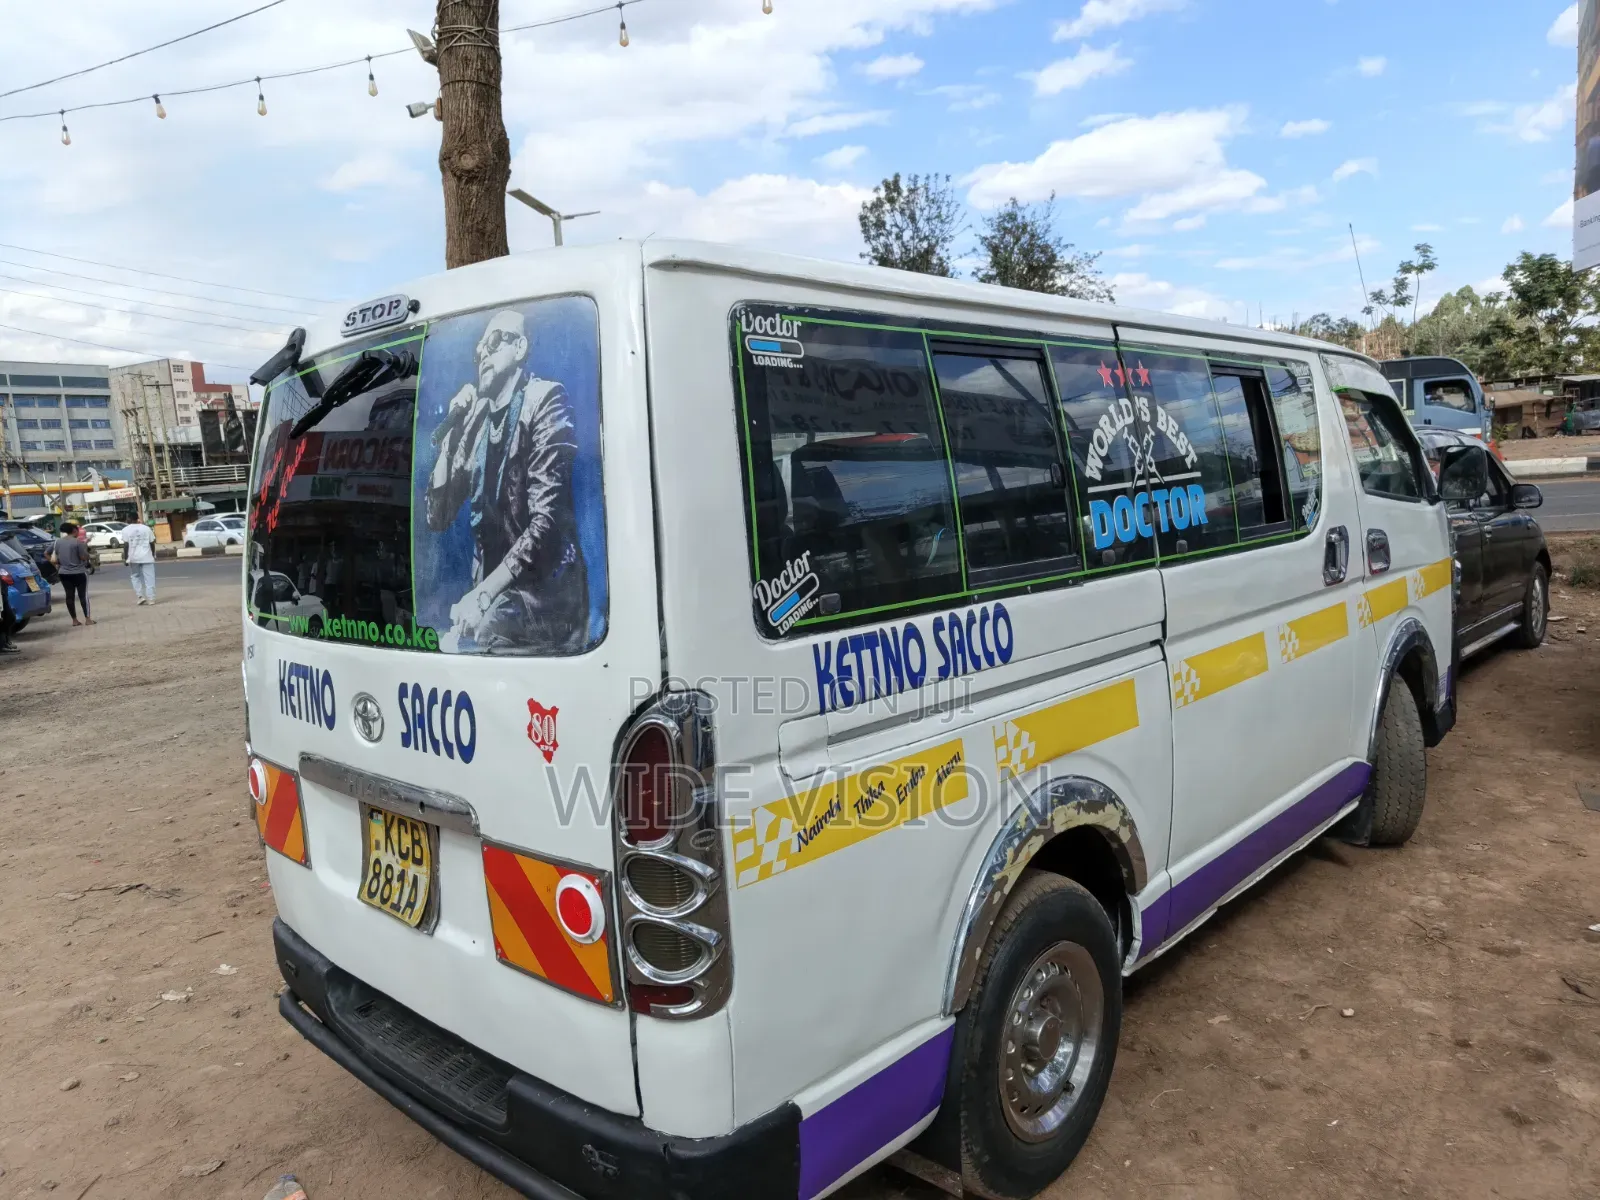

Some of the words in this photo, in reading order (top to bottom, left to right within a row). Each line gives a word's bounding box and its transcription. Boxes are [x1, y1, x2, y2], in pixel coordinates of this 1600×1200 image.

[344, 299, 401, 327] STOP
[737, 306, 802, 338] Doctor
[752, 355, 803, 369] LOADING...
[1085, 396, 1150, 481] WORLD'S
[1156, 404, 1198, 470] BEST
[1089, 484, 1209, 550] DOCTOR
[753, 549, 811, 611] Doctor
[289, 608, 439, 650] ww.ketnno.co.ke
[812, 622, 927, 715] KETTNO
[932, 602, 1014, 681] SACCO
[279, 659, 336, 731] KETTNO
[398, 682, 477, 764] SACCO
[531, 713, 555, 745] 80
[796, 794, 842, 852] Nairobi
[853, 780, 886, 819] Thika
[895, 765, 926, 805] Embu
[936, 751, 961, 786] Meru
[384, 812, 423, 866] KCB
[367, 858, 419, 920] 881A
